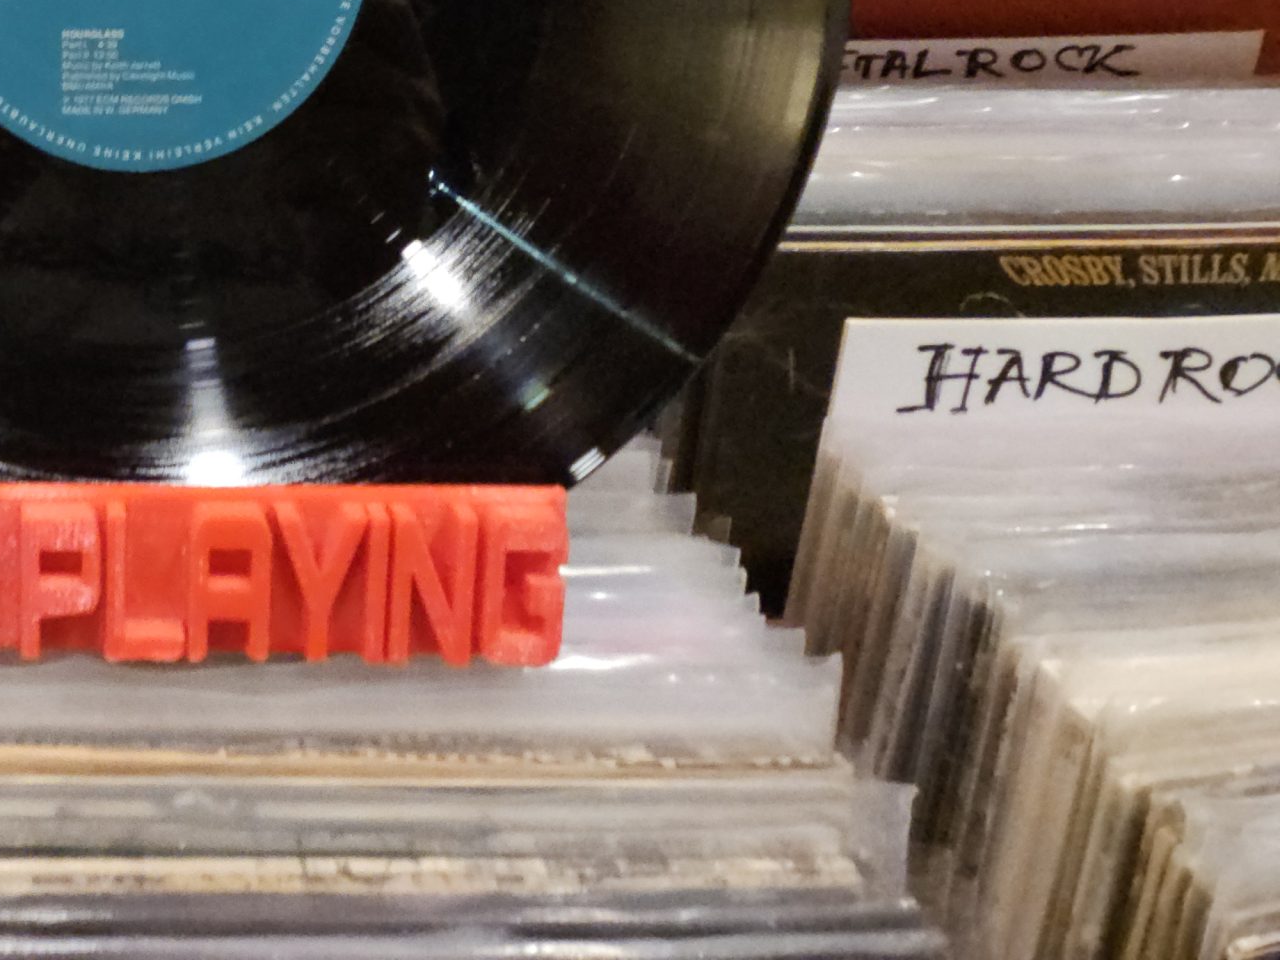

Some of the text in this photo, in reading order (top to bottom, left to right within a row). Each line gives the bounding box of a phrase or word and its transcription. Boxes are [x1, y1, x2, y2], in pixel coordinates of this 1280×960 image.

[955, 44, 1141, 78] ROCK
[999, 254, 1136, 288] CROSBY,
[1139, 252, 1251, 286] STILLS,
[895, 342, 1280, 414] HARD RO
[17, 495, 570, 668] PLAYING
